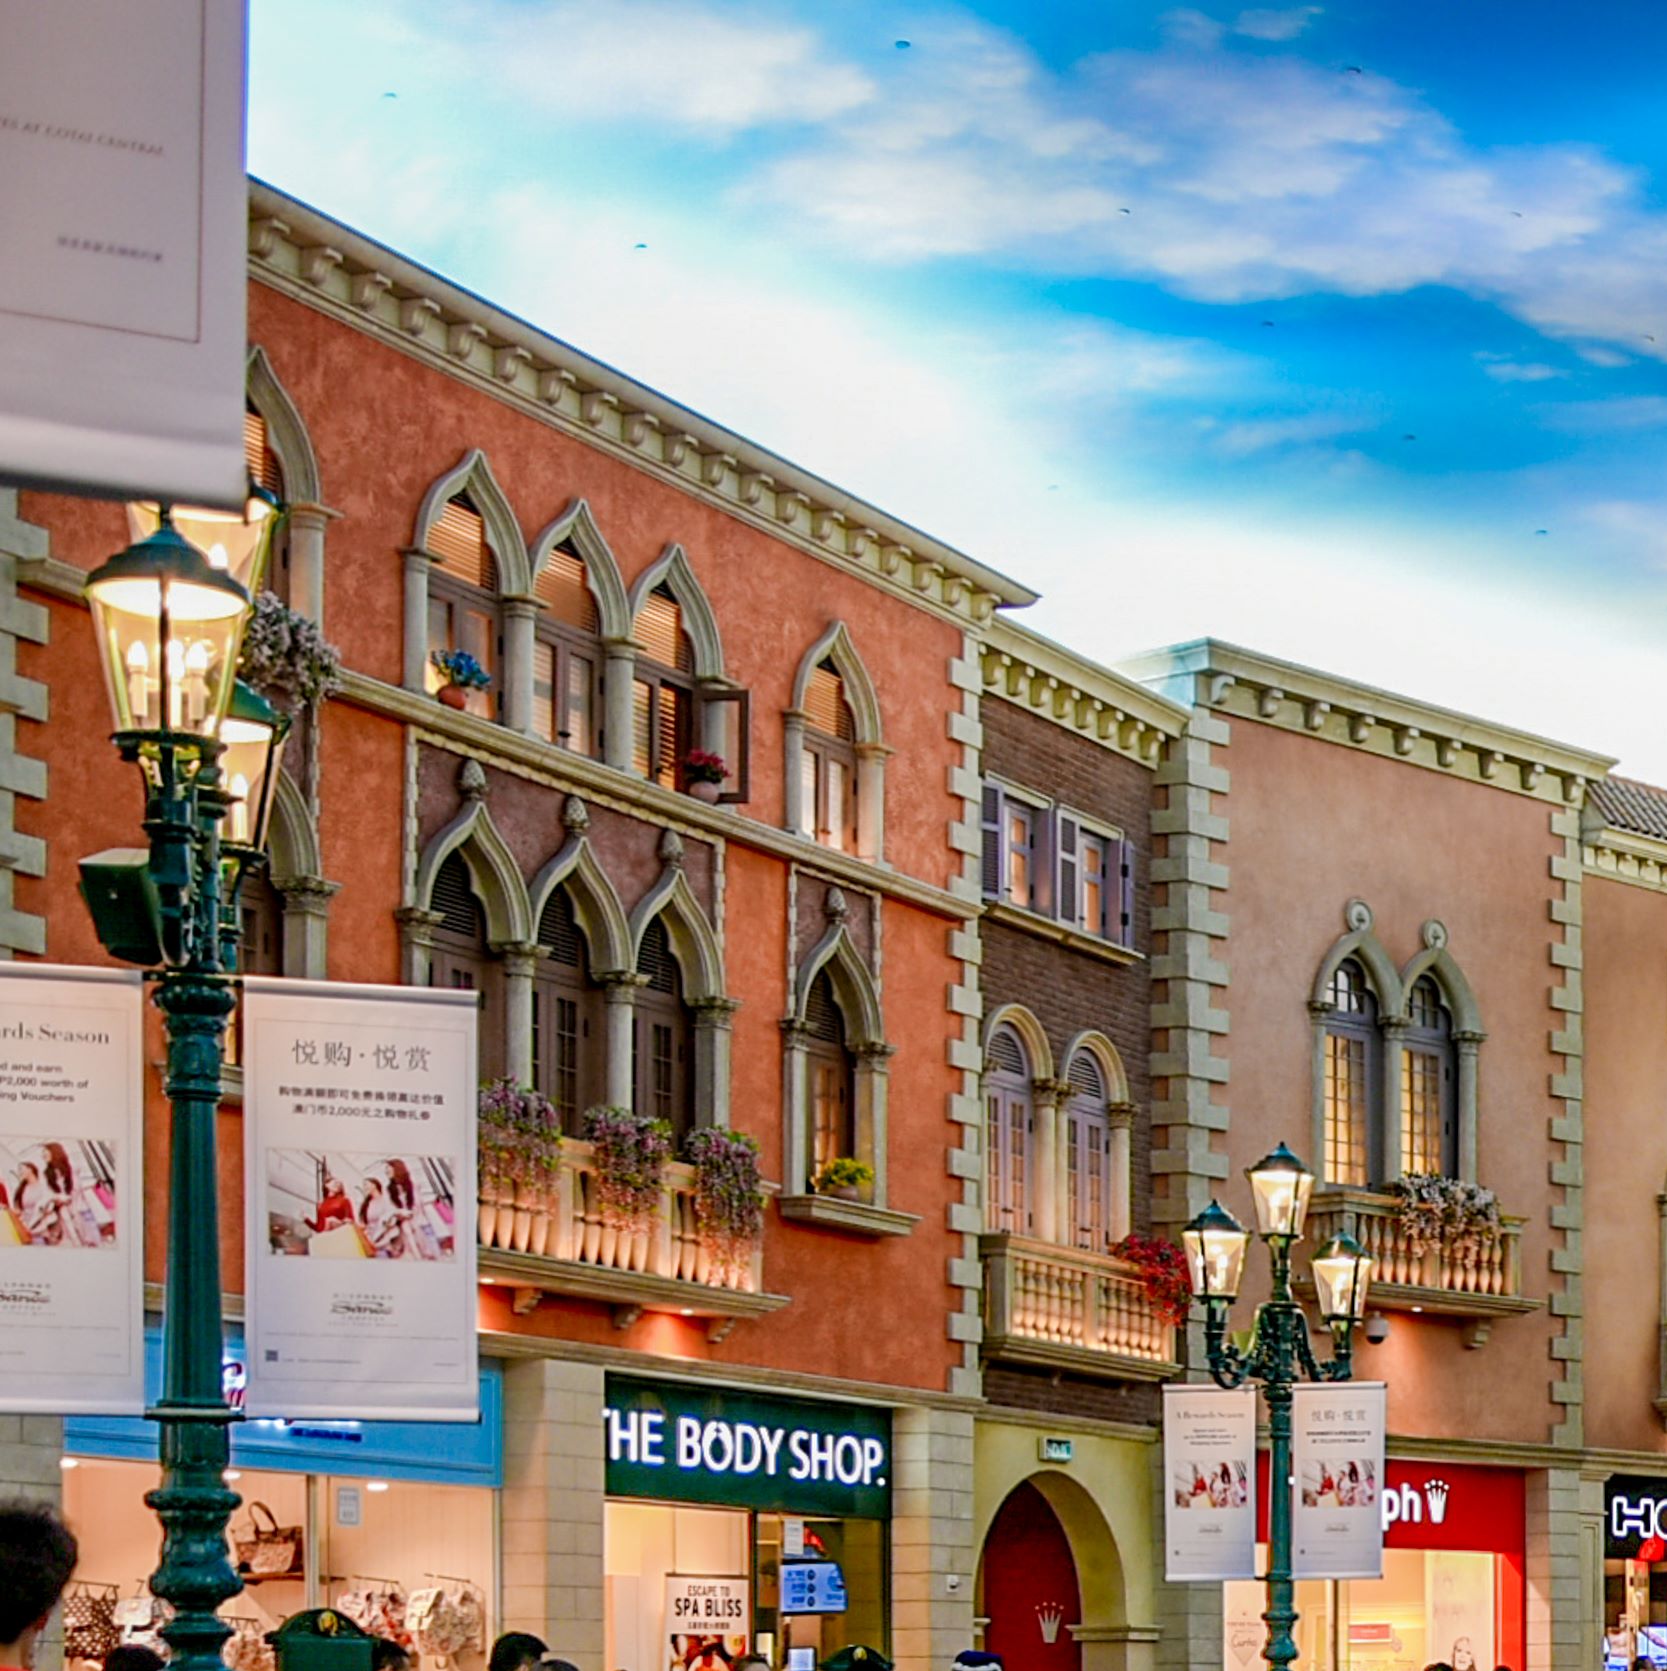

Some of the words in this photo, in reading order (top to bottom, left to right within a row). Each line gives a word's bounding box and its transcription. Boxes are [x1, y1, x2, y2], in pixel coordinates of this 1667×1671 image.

[0, 1021, 34, 1041] rds
[39, 1023, 109, 1044] Season
[41, 1078, 74, 1089] worth
[77, 1079, 89, 1090] of
[20, 1090, 75, 1103] Vouchers
[602, 1408, 665, 1465] HE
[677, 1415, 785, 1475] BODY
[687, 1584, 717, 1597] ESCAPE
[720, 1585, 730, 1597] TO
[675, 1597, 699, 1617] SPA
[705, 1598, 742, 1618] BLISS
